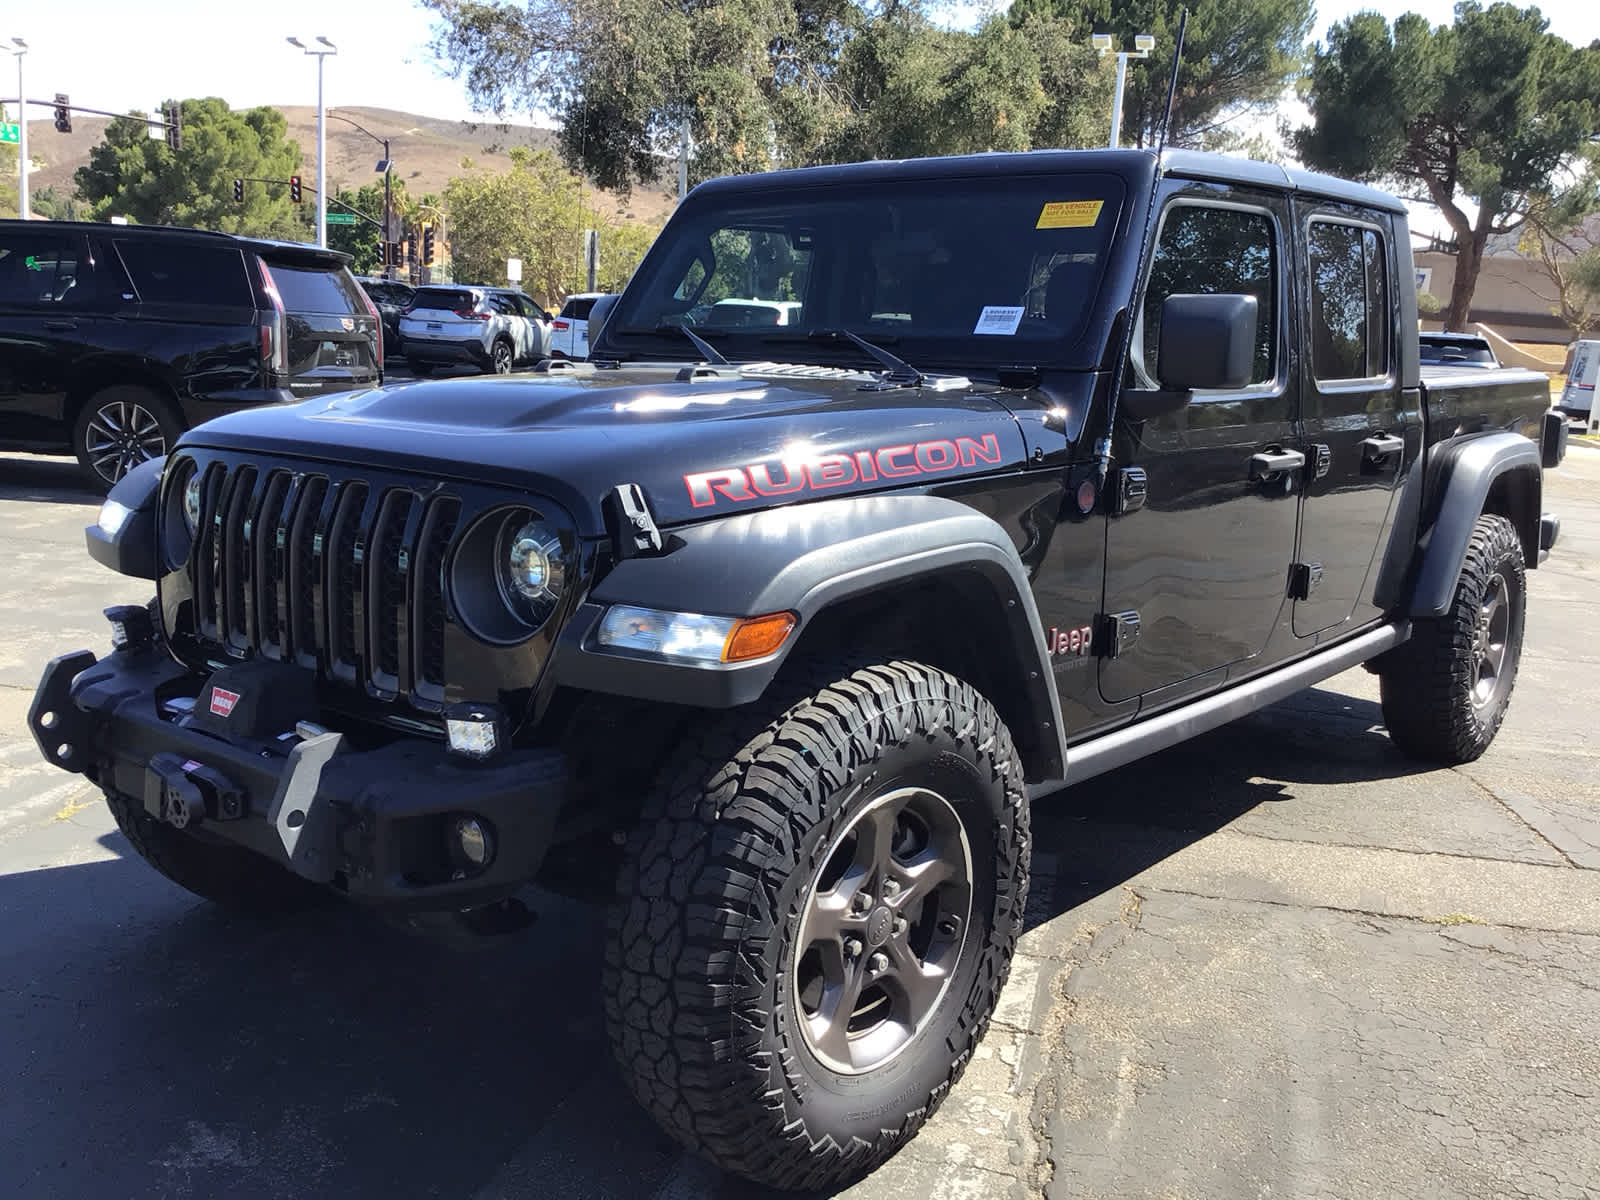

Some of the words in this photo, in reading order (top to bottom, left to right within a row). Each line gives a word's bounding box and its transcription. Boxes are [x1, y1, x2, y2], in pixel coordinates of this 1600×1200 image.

[1065, 201, 1098, 209] VEHICLE
[683, 433, 1001, 508] RUBICON
[1048, 626, 1092, 656] Jeep
